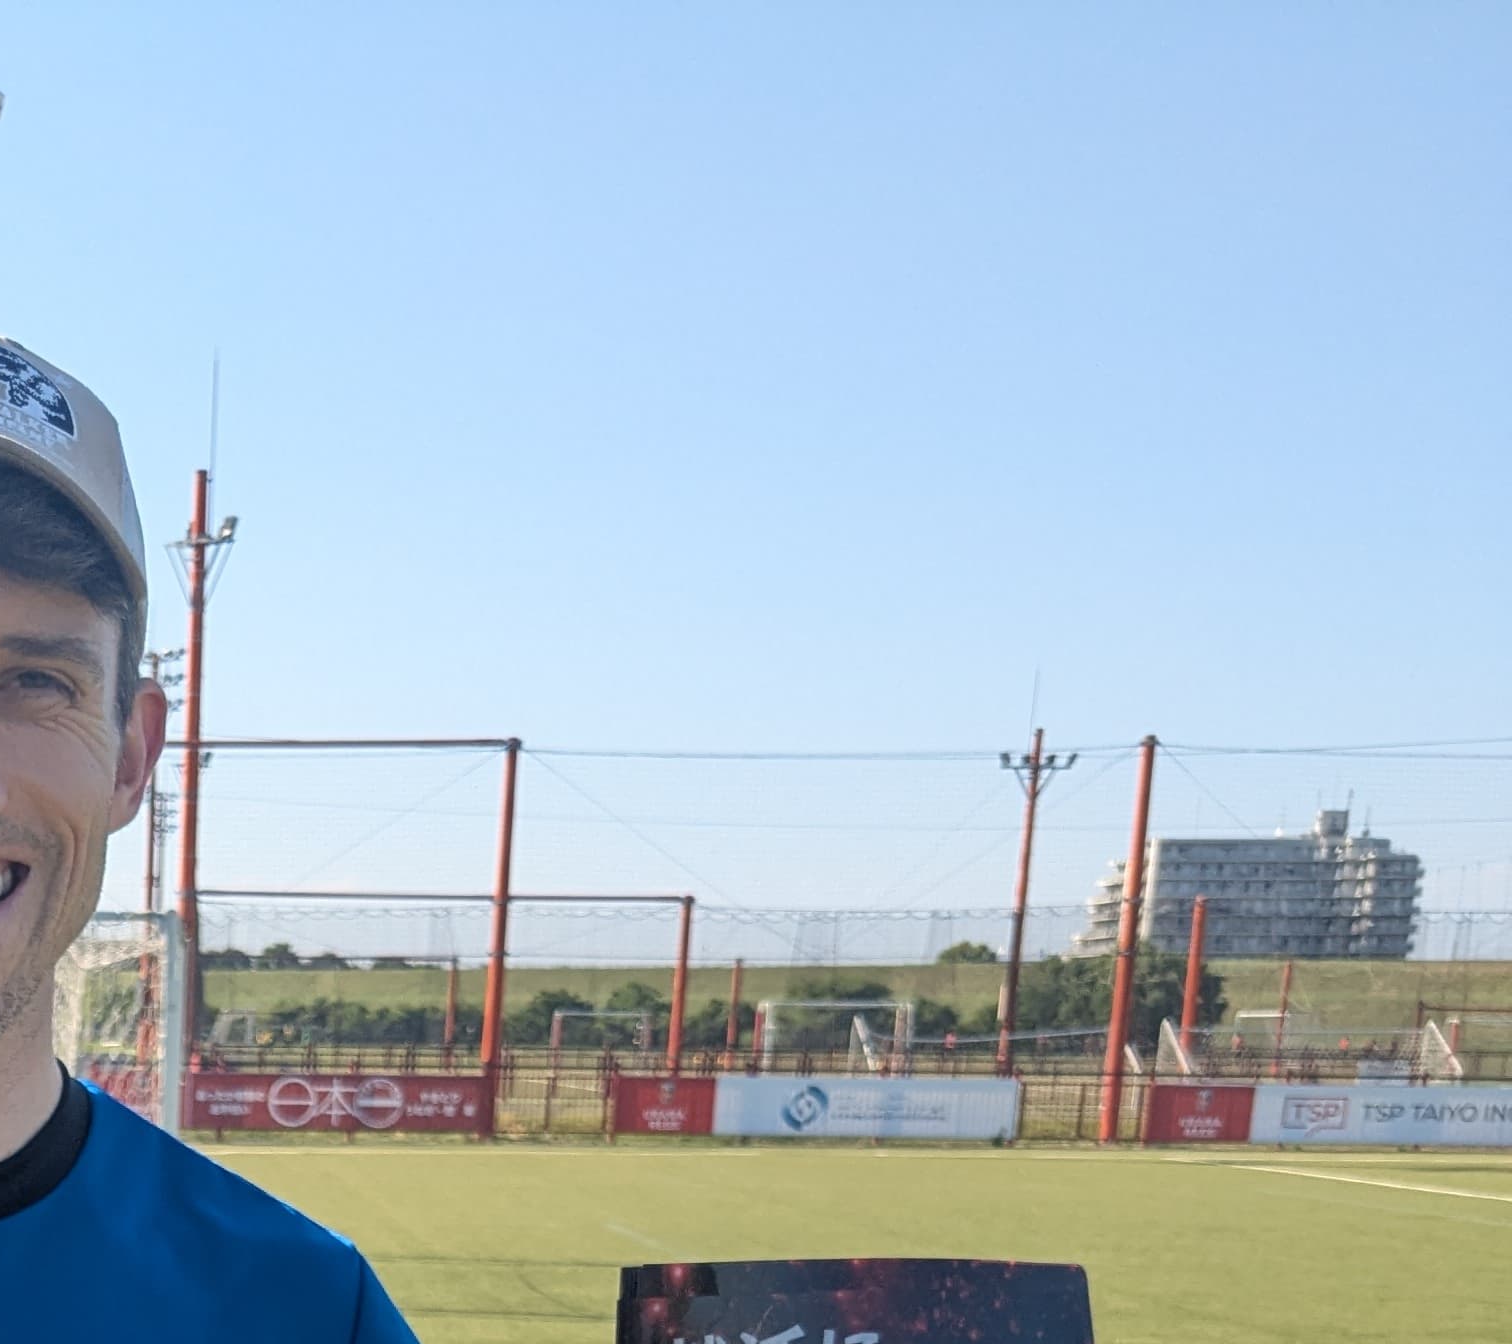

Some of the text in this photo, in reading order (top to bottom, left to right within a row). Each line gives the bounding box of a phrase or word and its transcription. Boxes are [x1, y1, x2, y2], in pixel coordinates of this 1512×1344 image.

[1294, 1103, 1340, 1122] TSP
[1362, 1104, 1406, 1123] TSP
[1412, 1102, 1479, 1123] TAIYO
